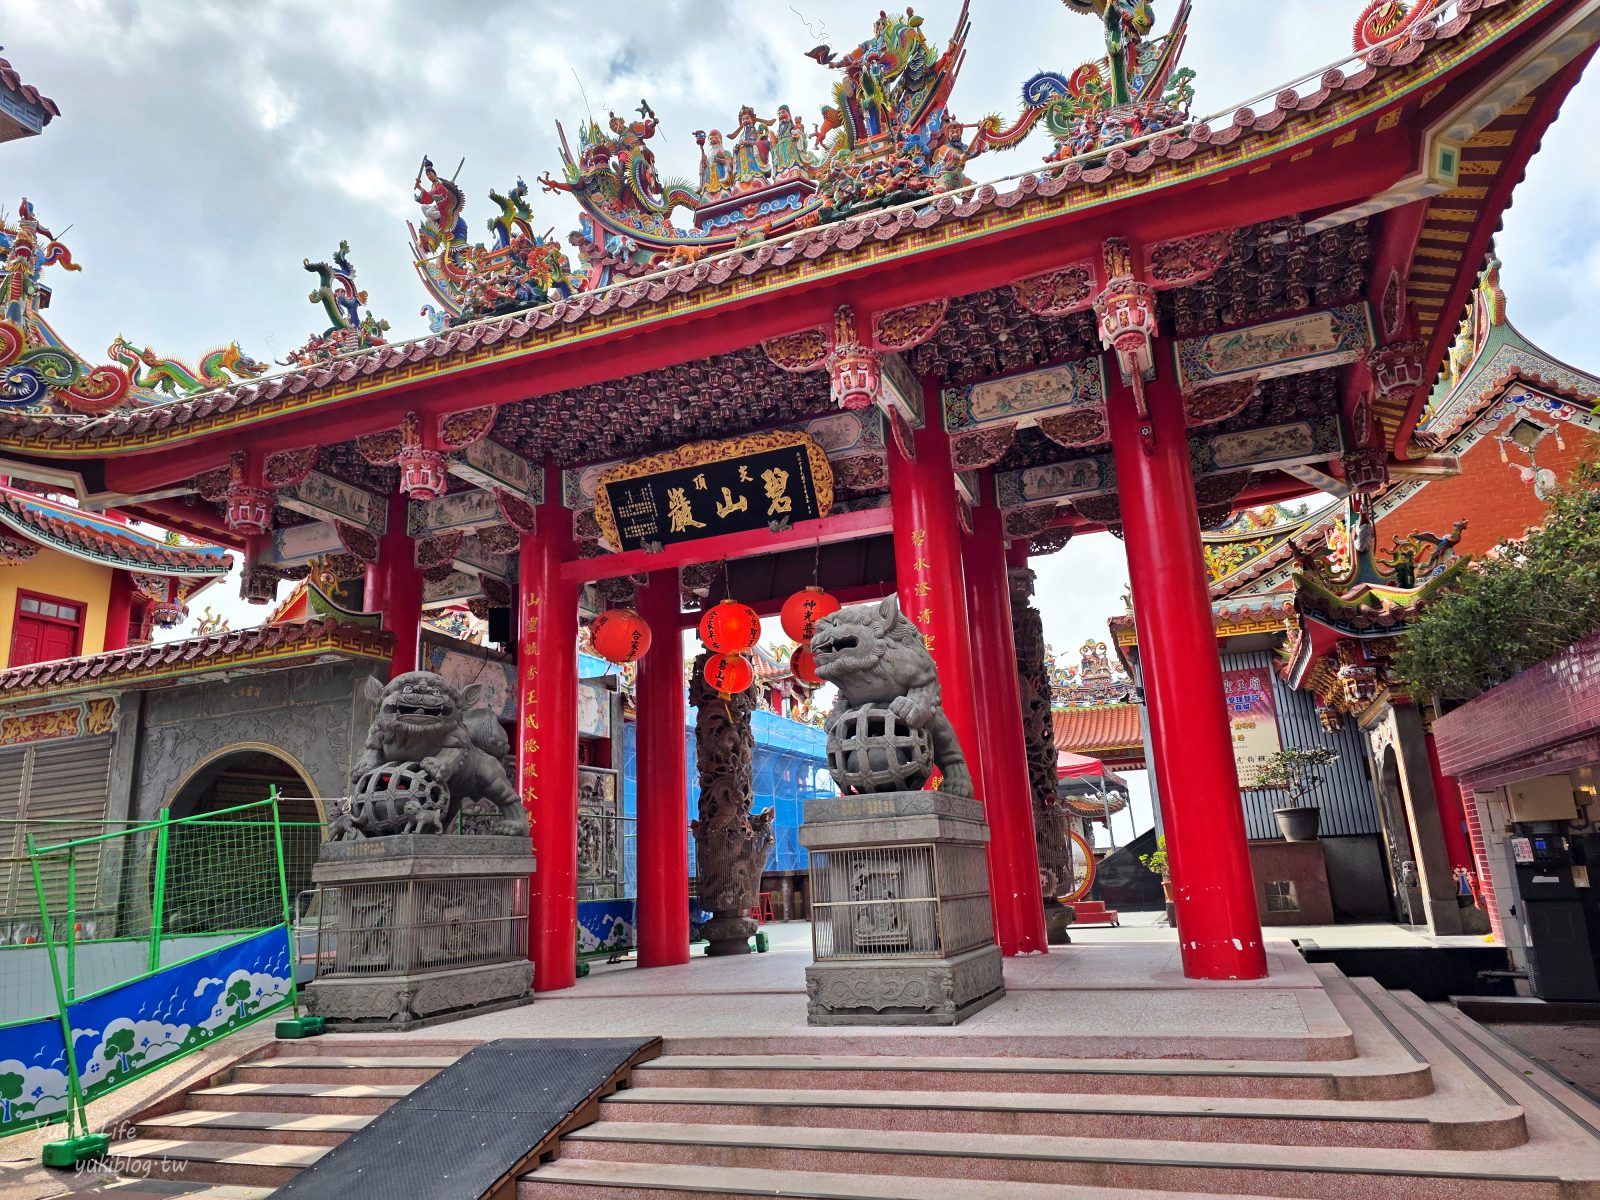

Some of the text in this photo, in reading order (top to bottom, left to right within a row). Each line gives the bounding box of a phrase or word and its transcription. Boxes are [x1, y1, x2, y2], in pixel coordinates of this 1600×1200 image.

[911, 529, 938, 669] 碧水澄清聖
[625, 630, 643, 663] 合家平
